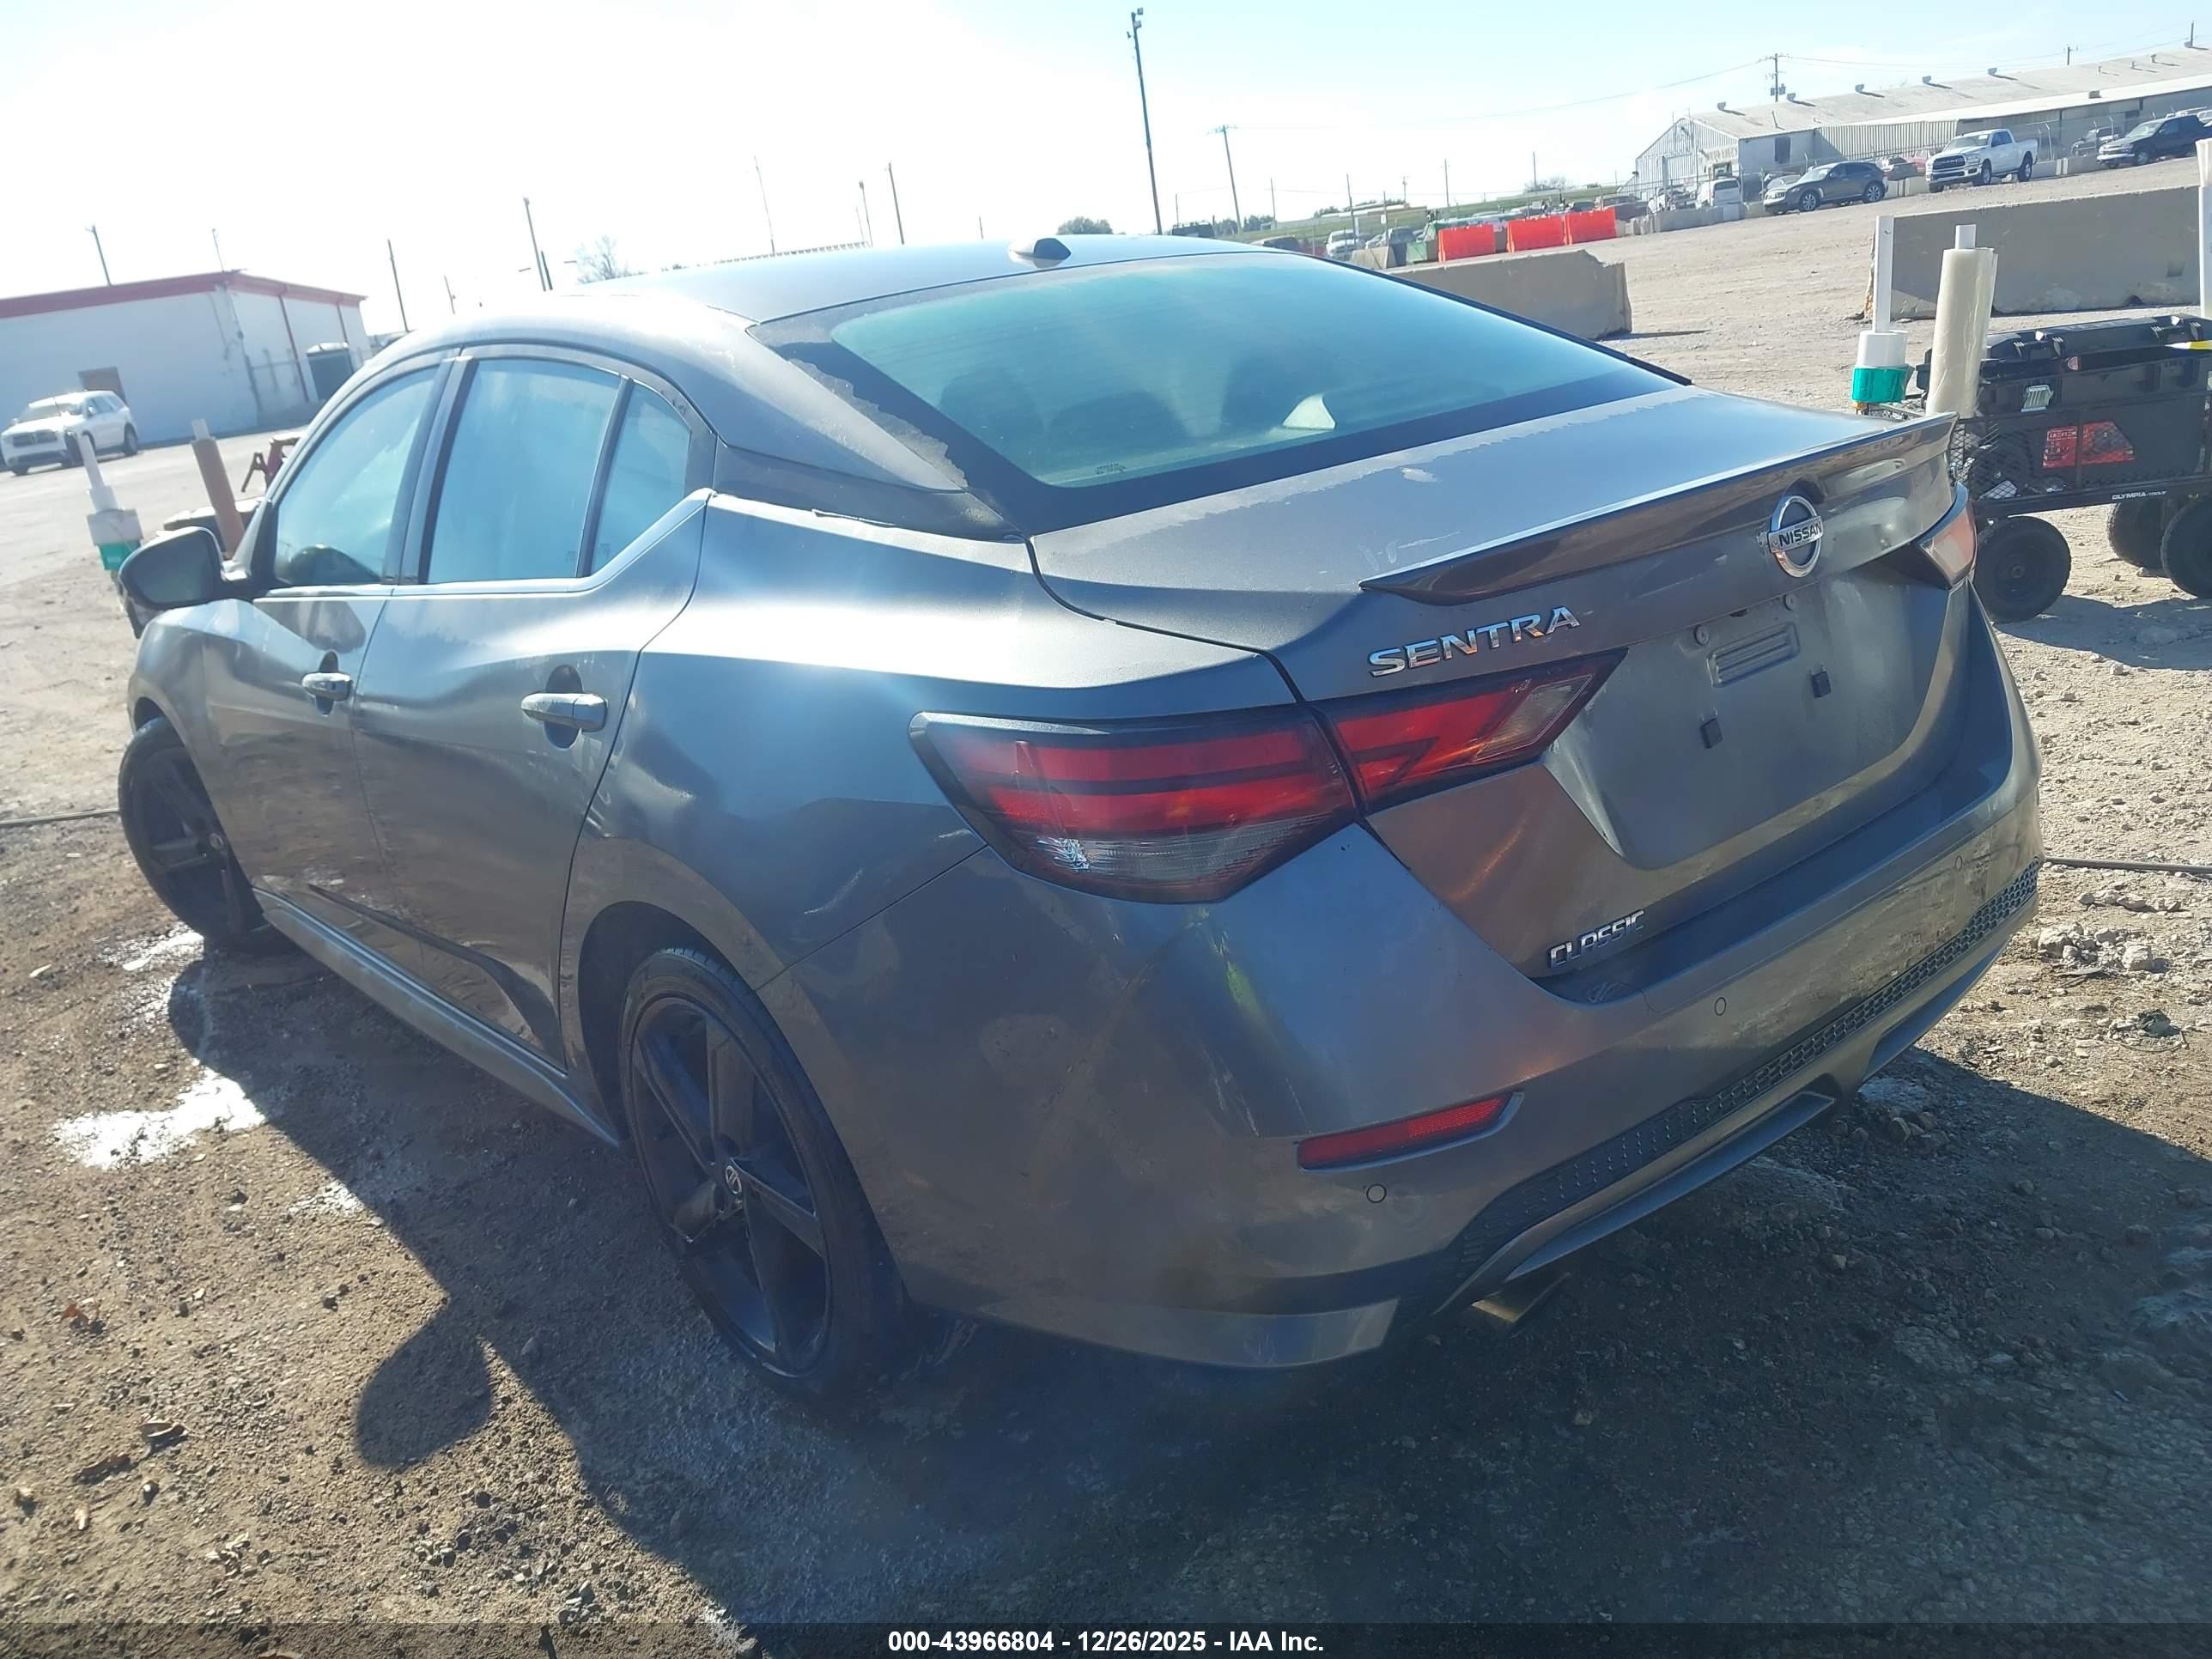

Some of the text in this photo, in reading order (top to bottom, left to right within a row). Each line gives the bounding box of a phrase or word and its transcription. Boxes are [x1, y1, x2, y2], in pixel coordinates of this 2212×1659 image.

[2112, 491, 2147, 500] OLYMPIA
[1778, 521, 1823, 547] NISSAN
[1369, 606, 1581, 677] SENTRA
